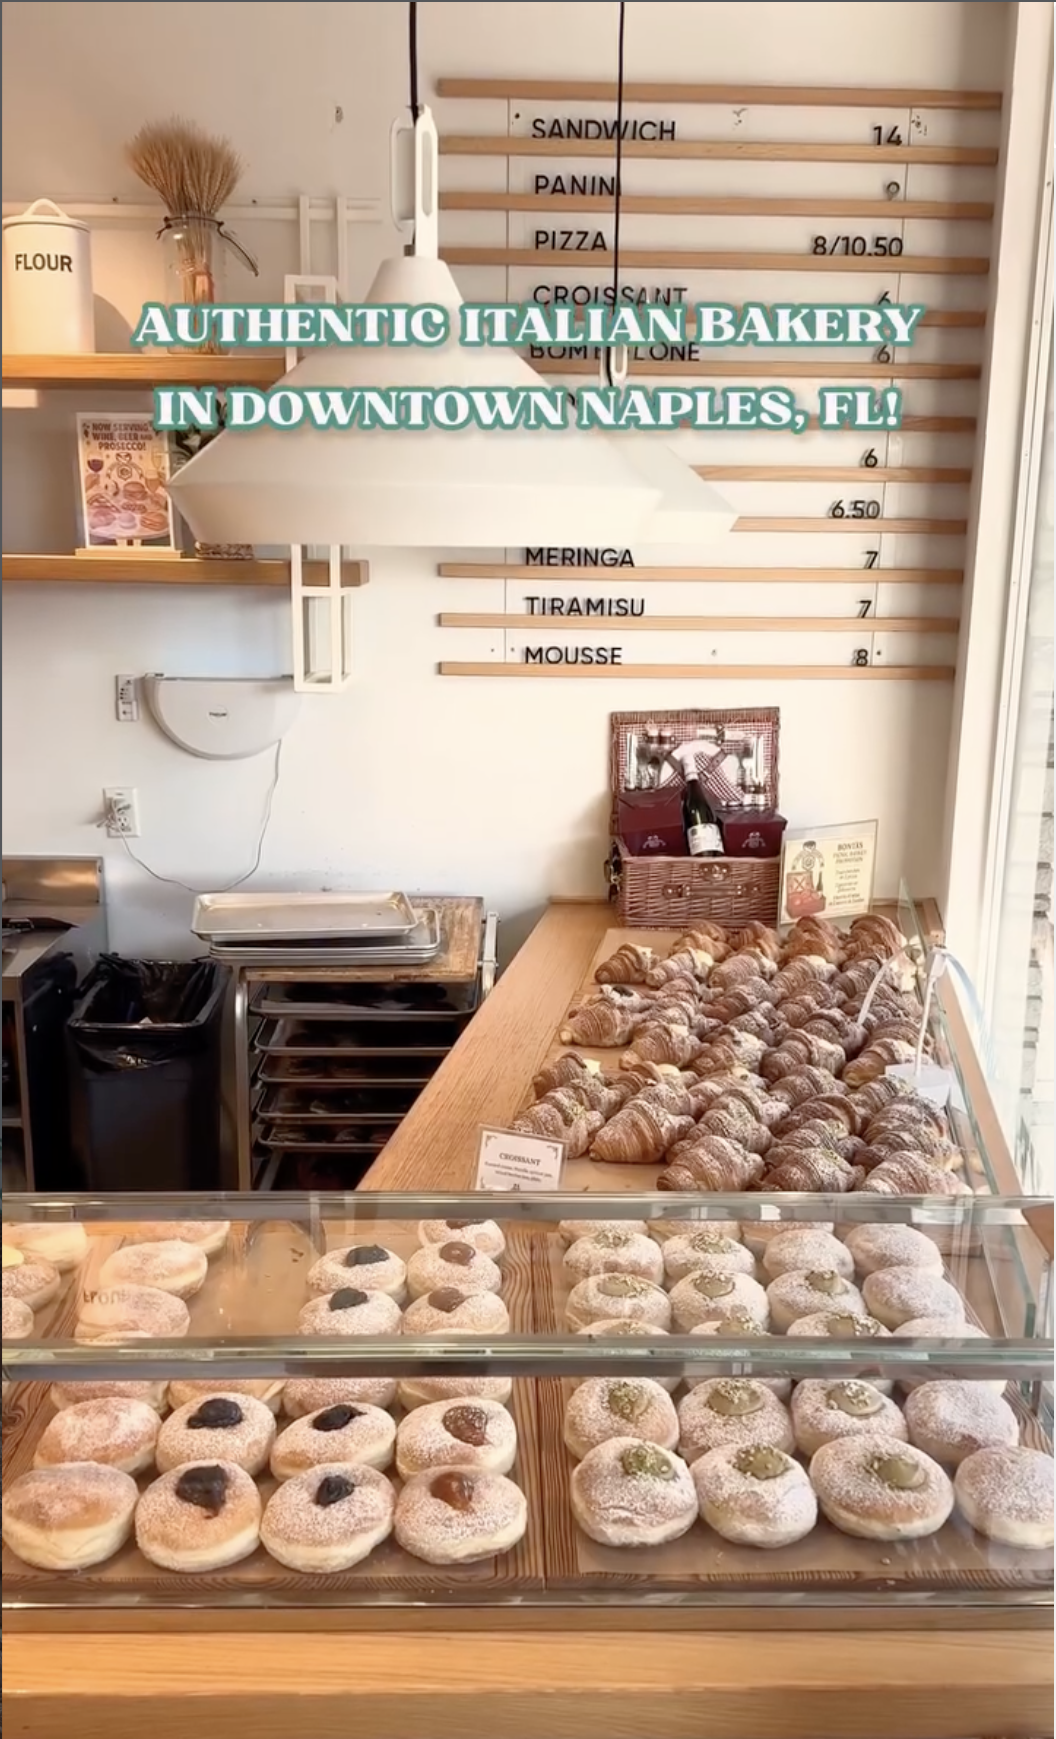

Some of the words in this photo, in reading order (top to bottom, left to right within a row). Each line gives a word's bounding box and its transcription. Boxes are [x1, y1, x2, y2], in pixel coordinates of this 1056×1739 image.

[532, 118, 676, 141] SANDWICH
[872, 125, 902, 146] 14
[534, 174, 622, 196] PANIN
[534, 230, 607, 251] PIZZA
[812, 235, 904, 257] 8/10.50
[14, 253, 73, 273] FLOUR
[533, 285, 688, 306] CROISSANT
[530, 342, 700, 362] BOMLONE
[877, 344, 891, 363] 6
[864, 448, 878, 468] 6
[831, 499, 881, 519] 6.50
[525, 547, 635, 567] MERINGA
[865, 550, 878, 569] 7
[525, 596, 645, 616] TIRAMISU
[859, 600, 872, 618] 7
[525, 646, 622, 665] MOUSSE
[855, 648, 868, 666] 8
[499, 1152, 541, 1166] CROISSANT
